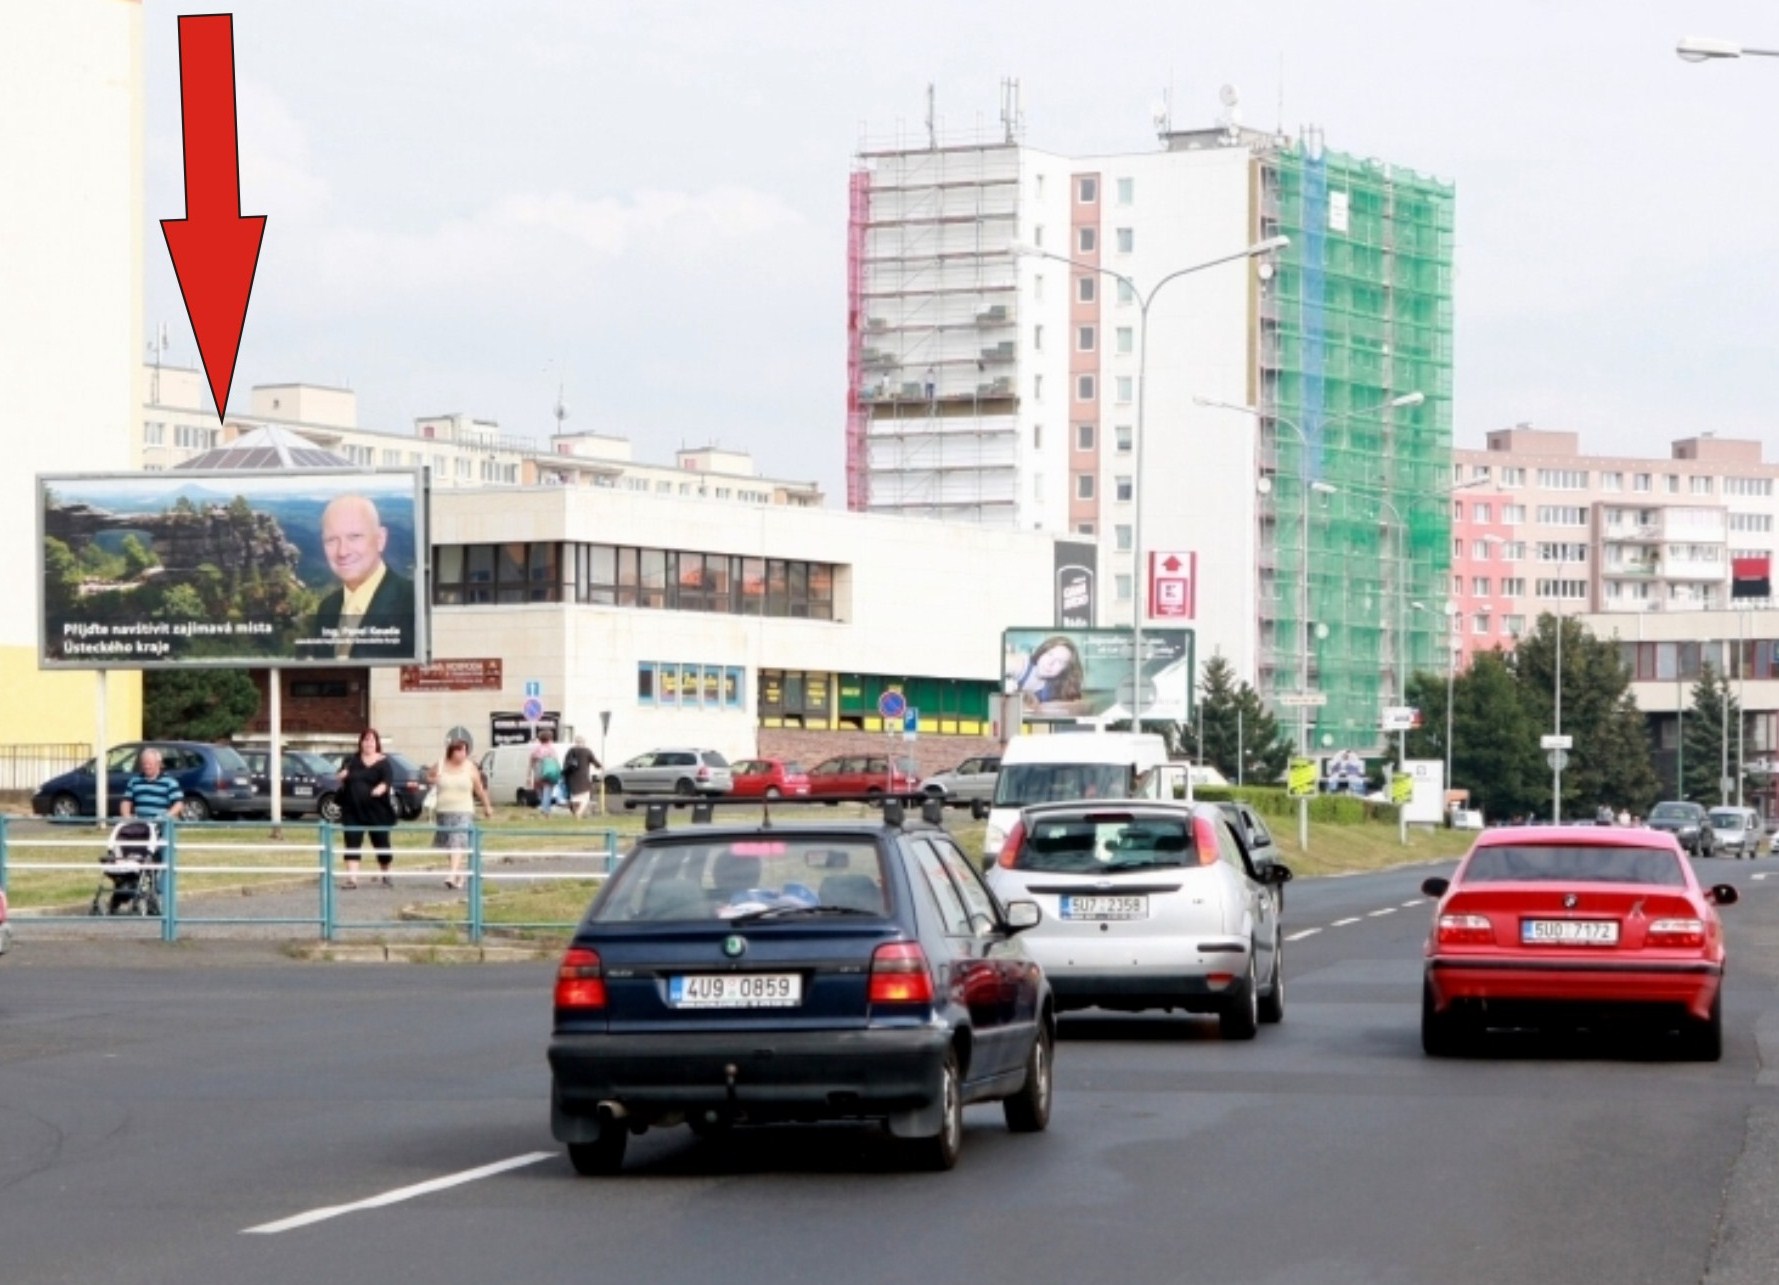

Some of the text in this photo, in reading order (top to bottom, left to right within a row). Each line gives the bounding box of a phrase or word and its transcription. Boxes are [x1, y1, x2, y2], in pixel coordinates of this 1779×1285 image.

[235, 621, 273, 634] místa
[135, 640, 170, 656] kraje
[687, 978, 790, 998] 4U9 0859
